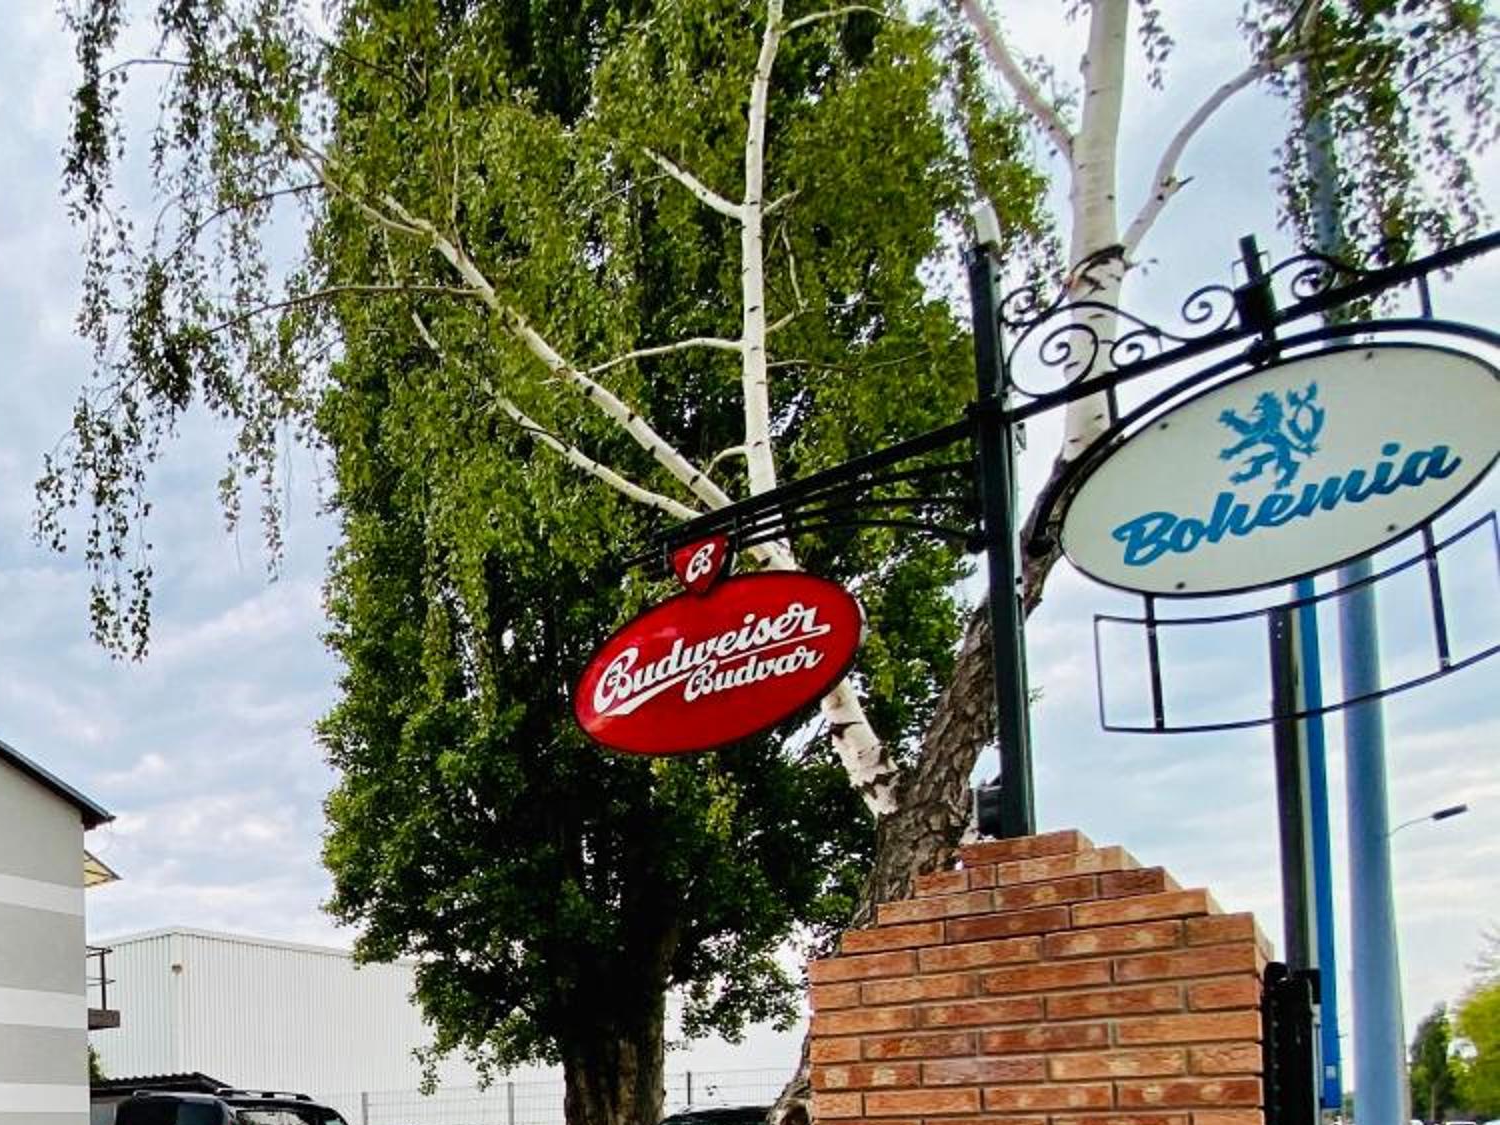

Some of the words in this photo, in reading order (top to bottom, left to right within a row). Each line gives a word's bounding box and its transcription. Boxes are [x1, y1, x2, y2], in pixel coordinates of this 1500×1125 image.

[1111, 442, 1462, 566] Bohemia
[685, 542, 716, 583] B
[593, 602, 831, 715] Budweiser
[684, 645, 824, 701] Budvar
